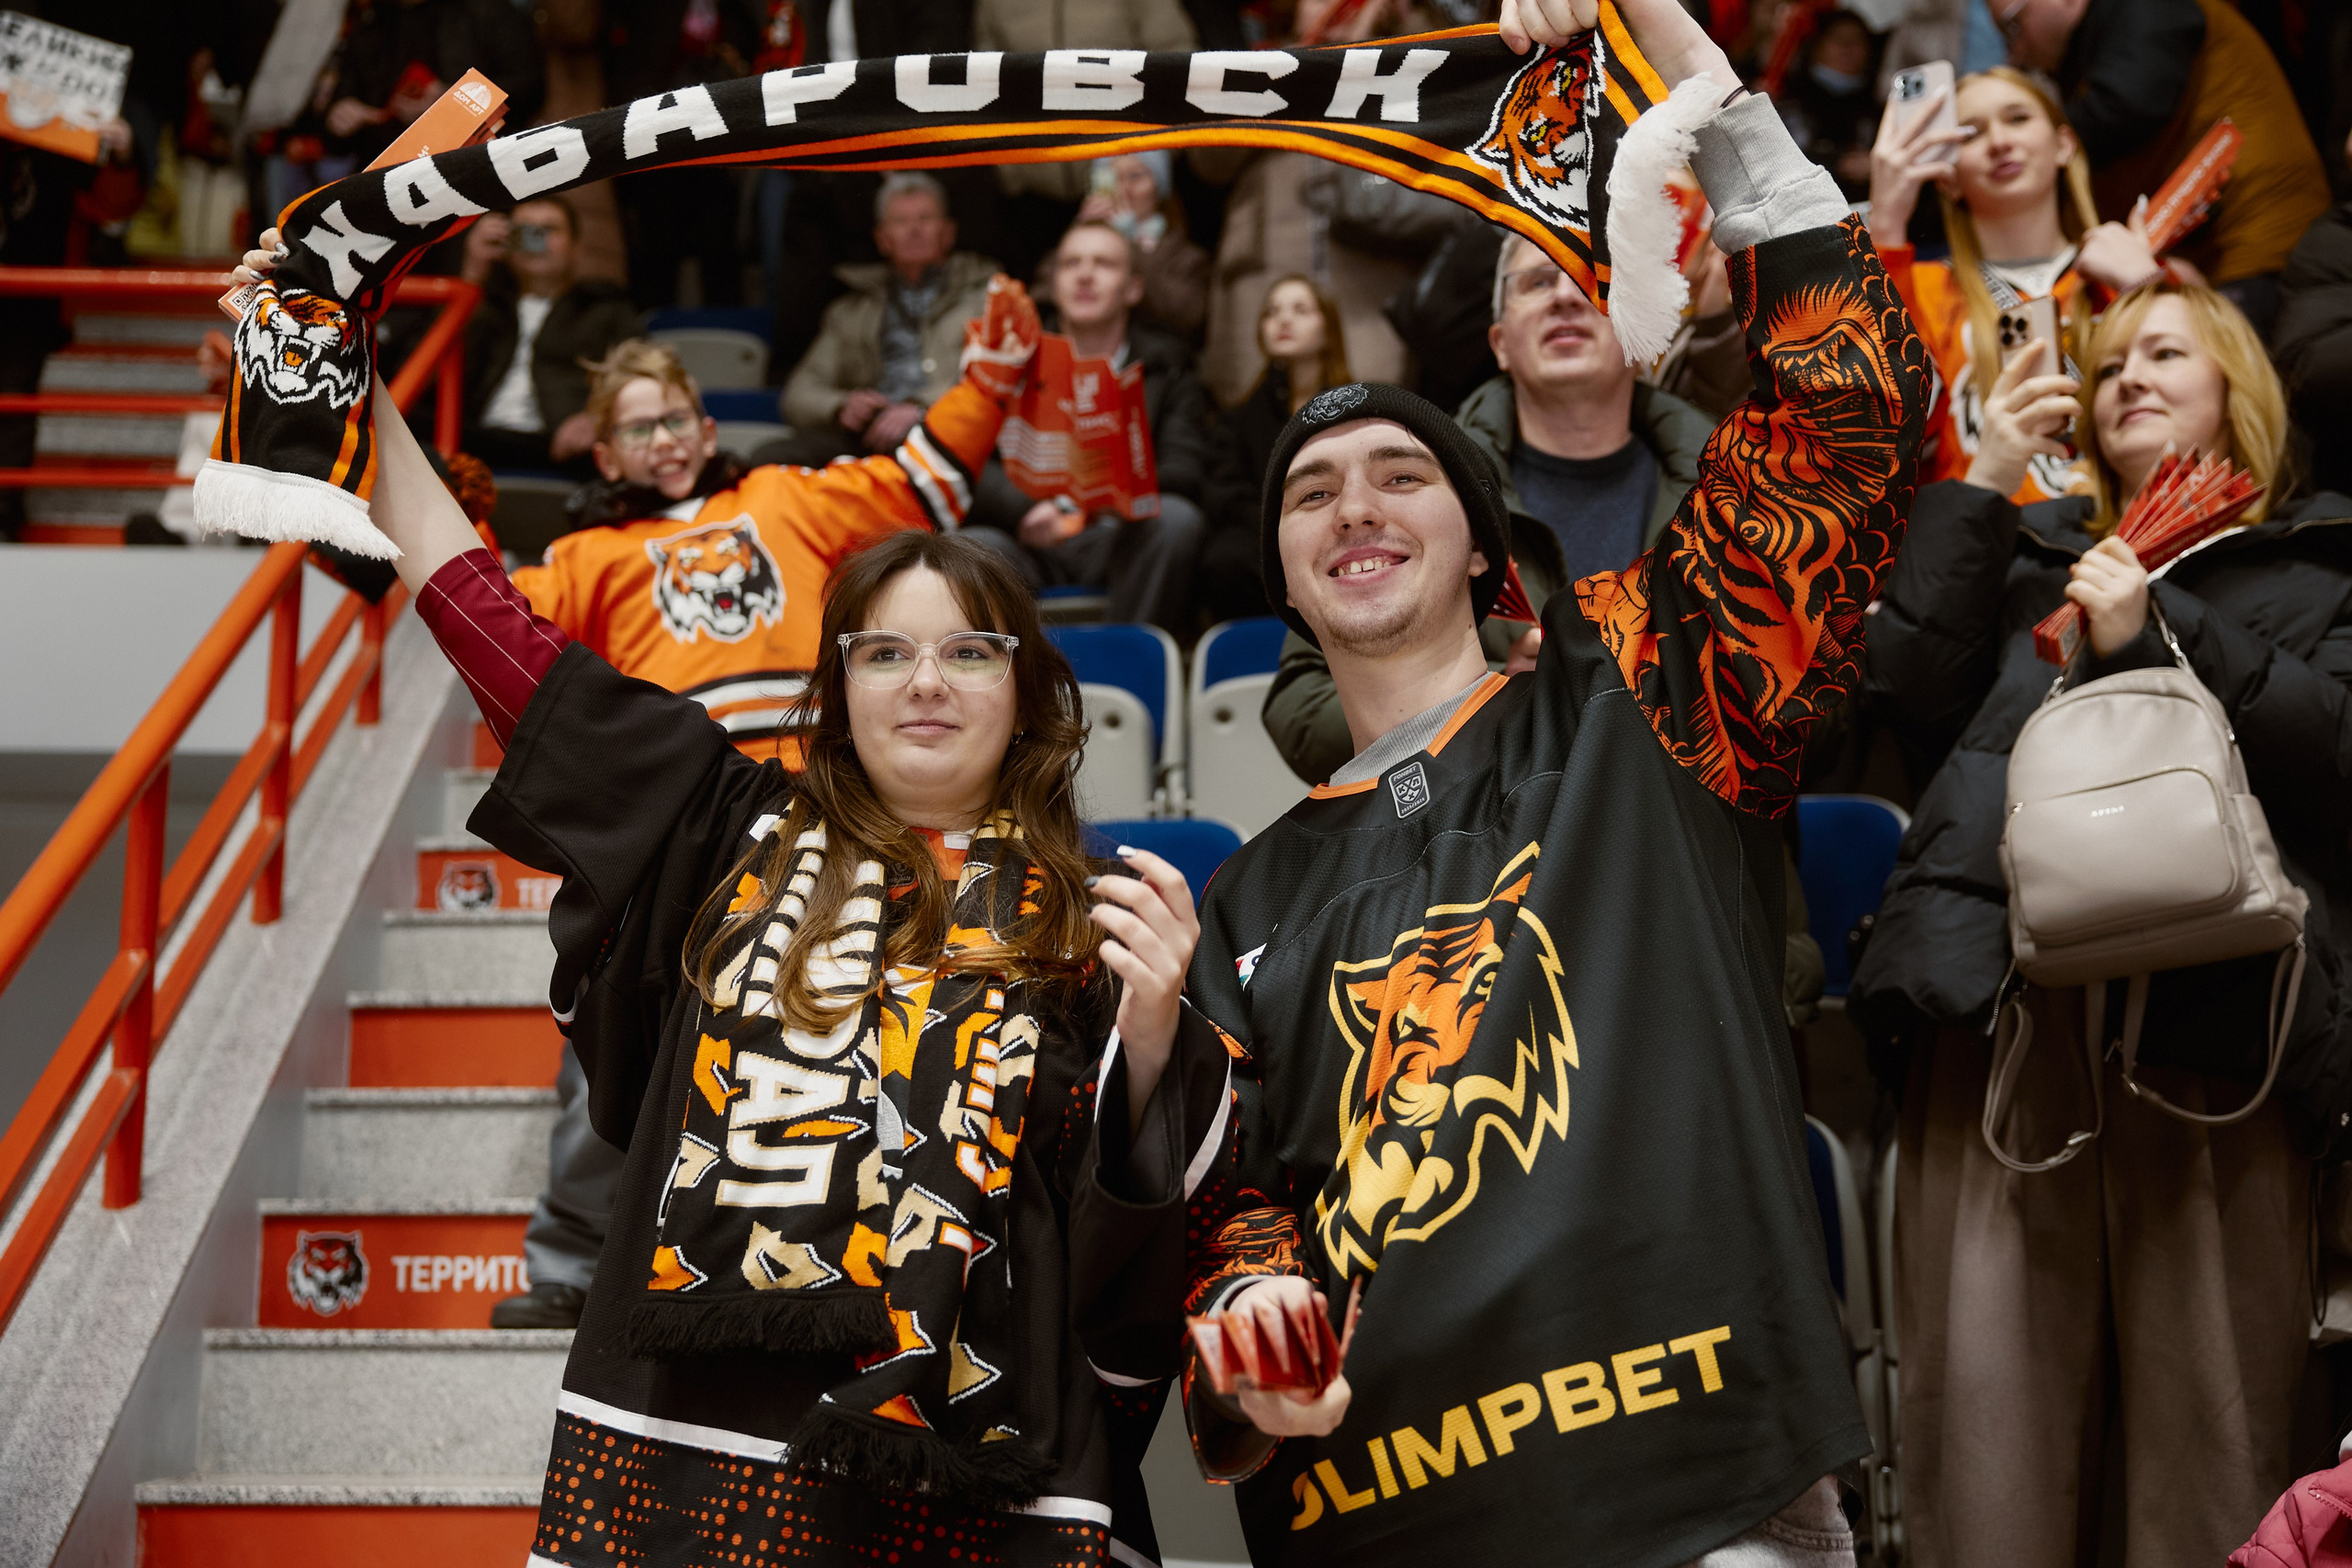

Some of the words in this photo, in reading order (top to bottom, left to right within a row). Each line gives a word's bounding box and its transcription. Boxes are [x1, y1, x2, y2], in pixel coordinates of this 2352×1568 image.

[453, 90, 470, 106] ДОМ
[469, 101, 485, 116] АРТ
[301, 49, 1450, 300] ХАБАРОВСК
